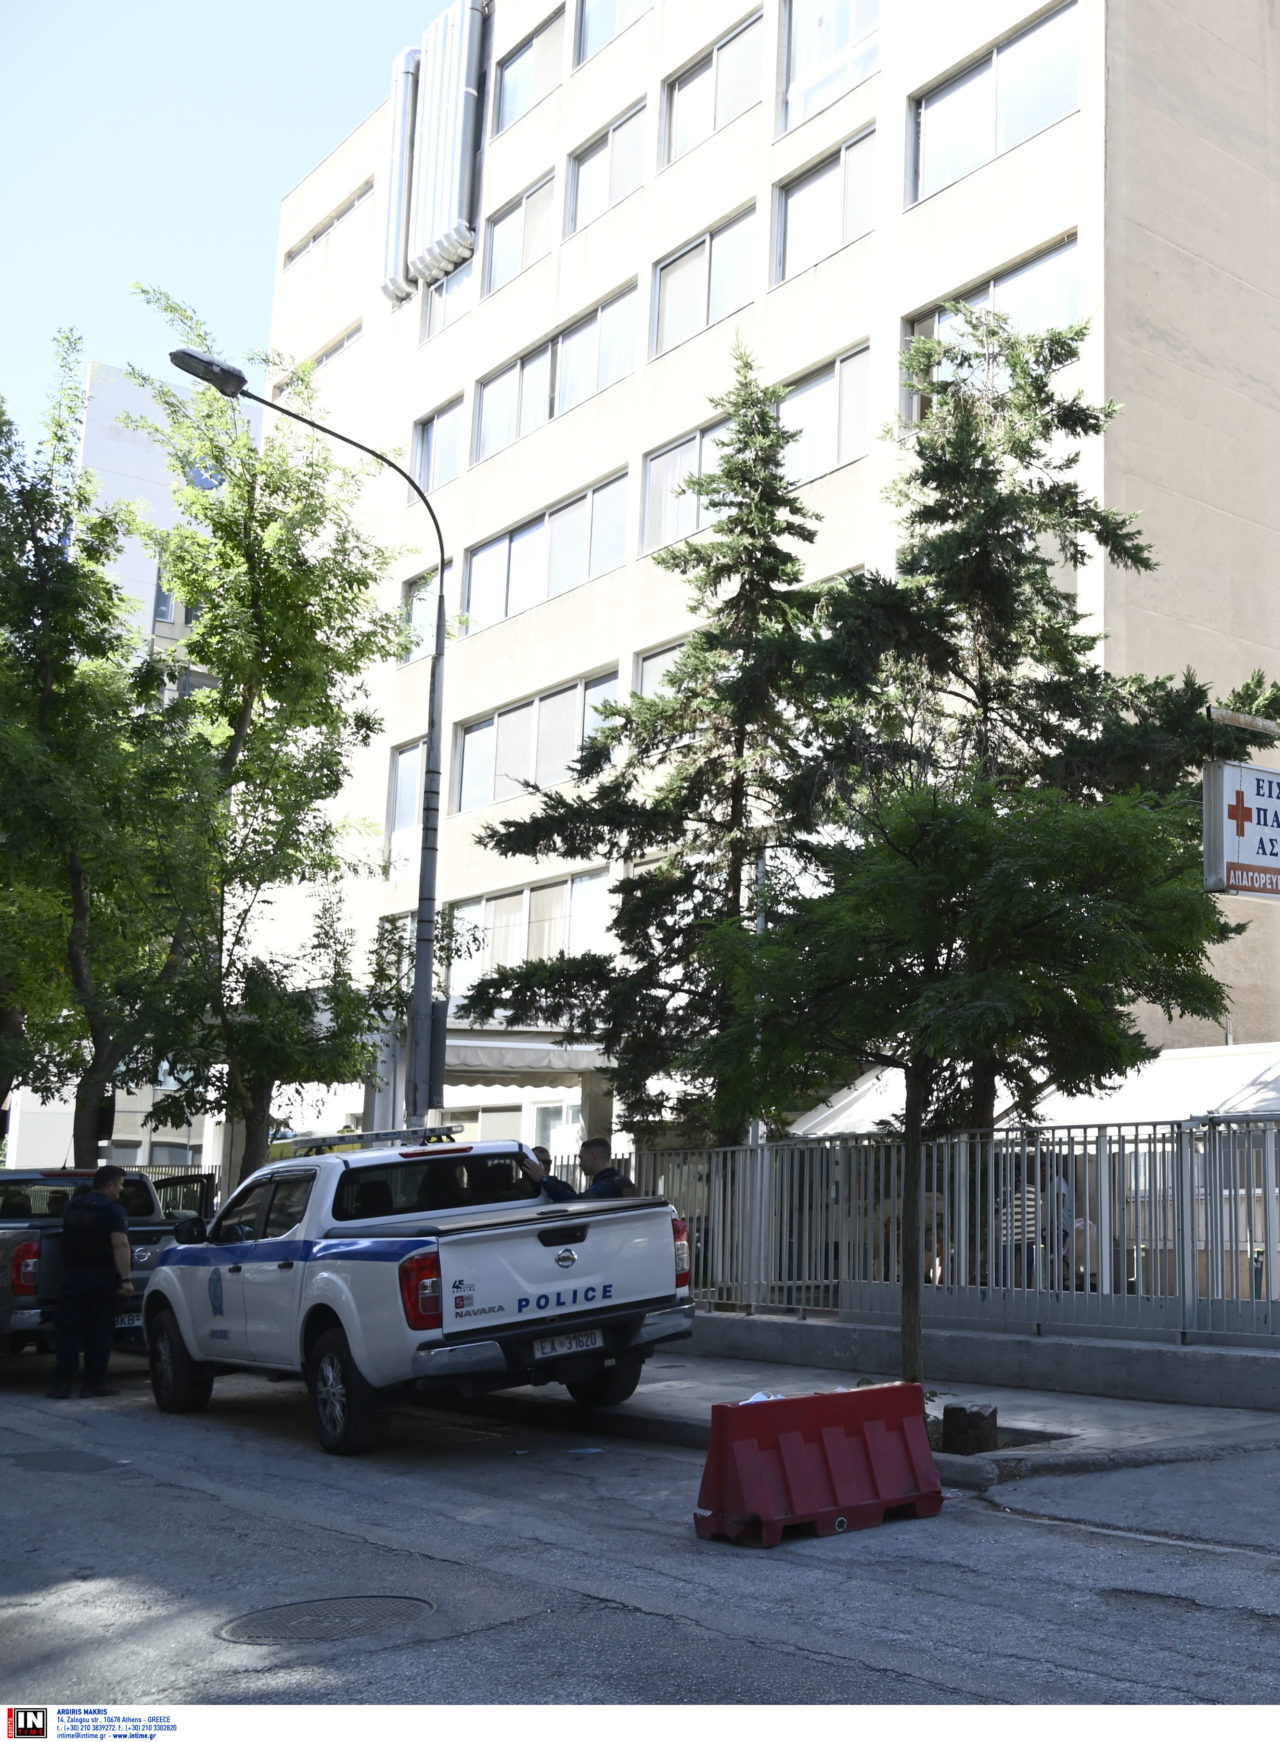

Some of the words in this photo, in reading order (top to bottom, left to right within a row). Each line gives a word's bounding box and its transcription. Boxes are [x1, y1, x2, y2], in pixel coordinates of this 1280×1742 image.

[517, 1284, 613, 1314] POLICE
[454, 1304, 505, 1319] NAVARA
[566, 1331, 597, 1351] 31620
